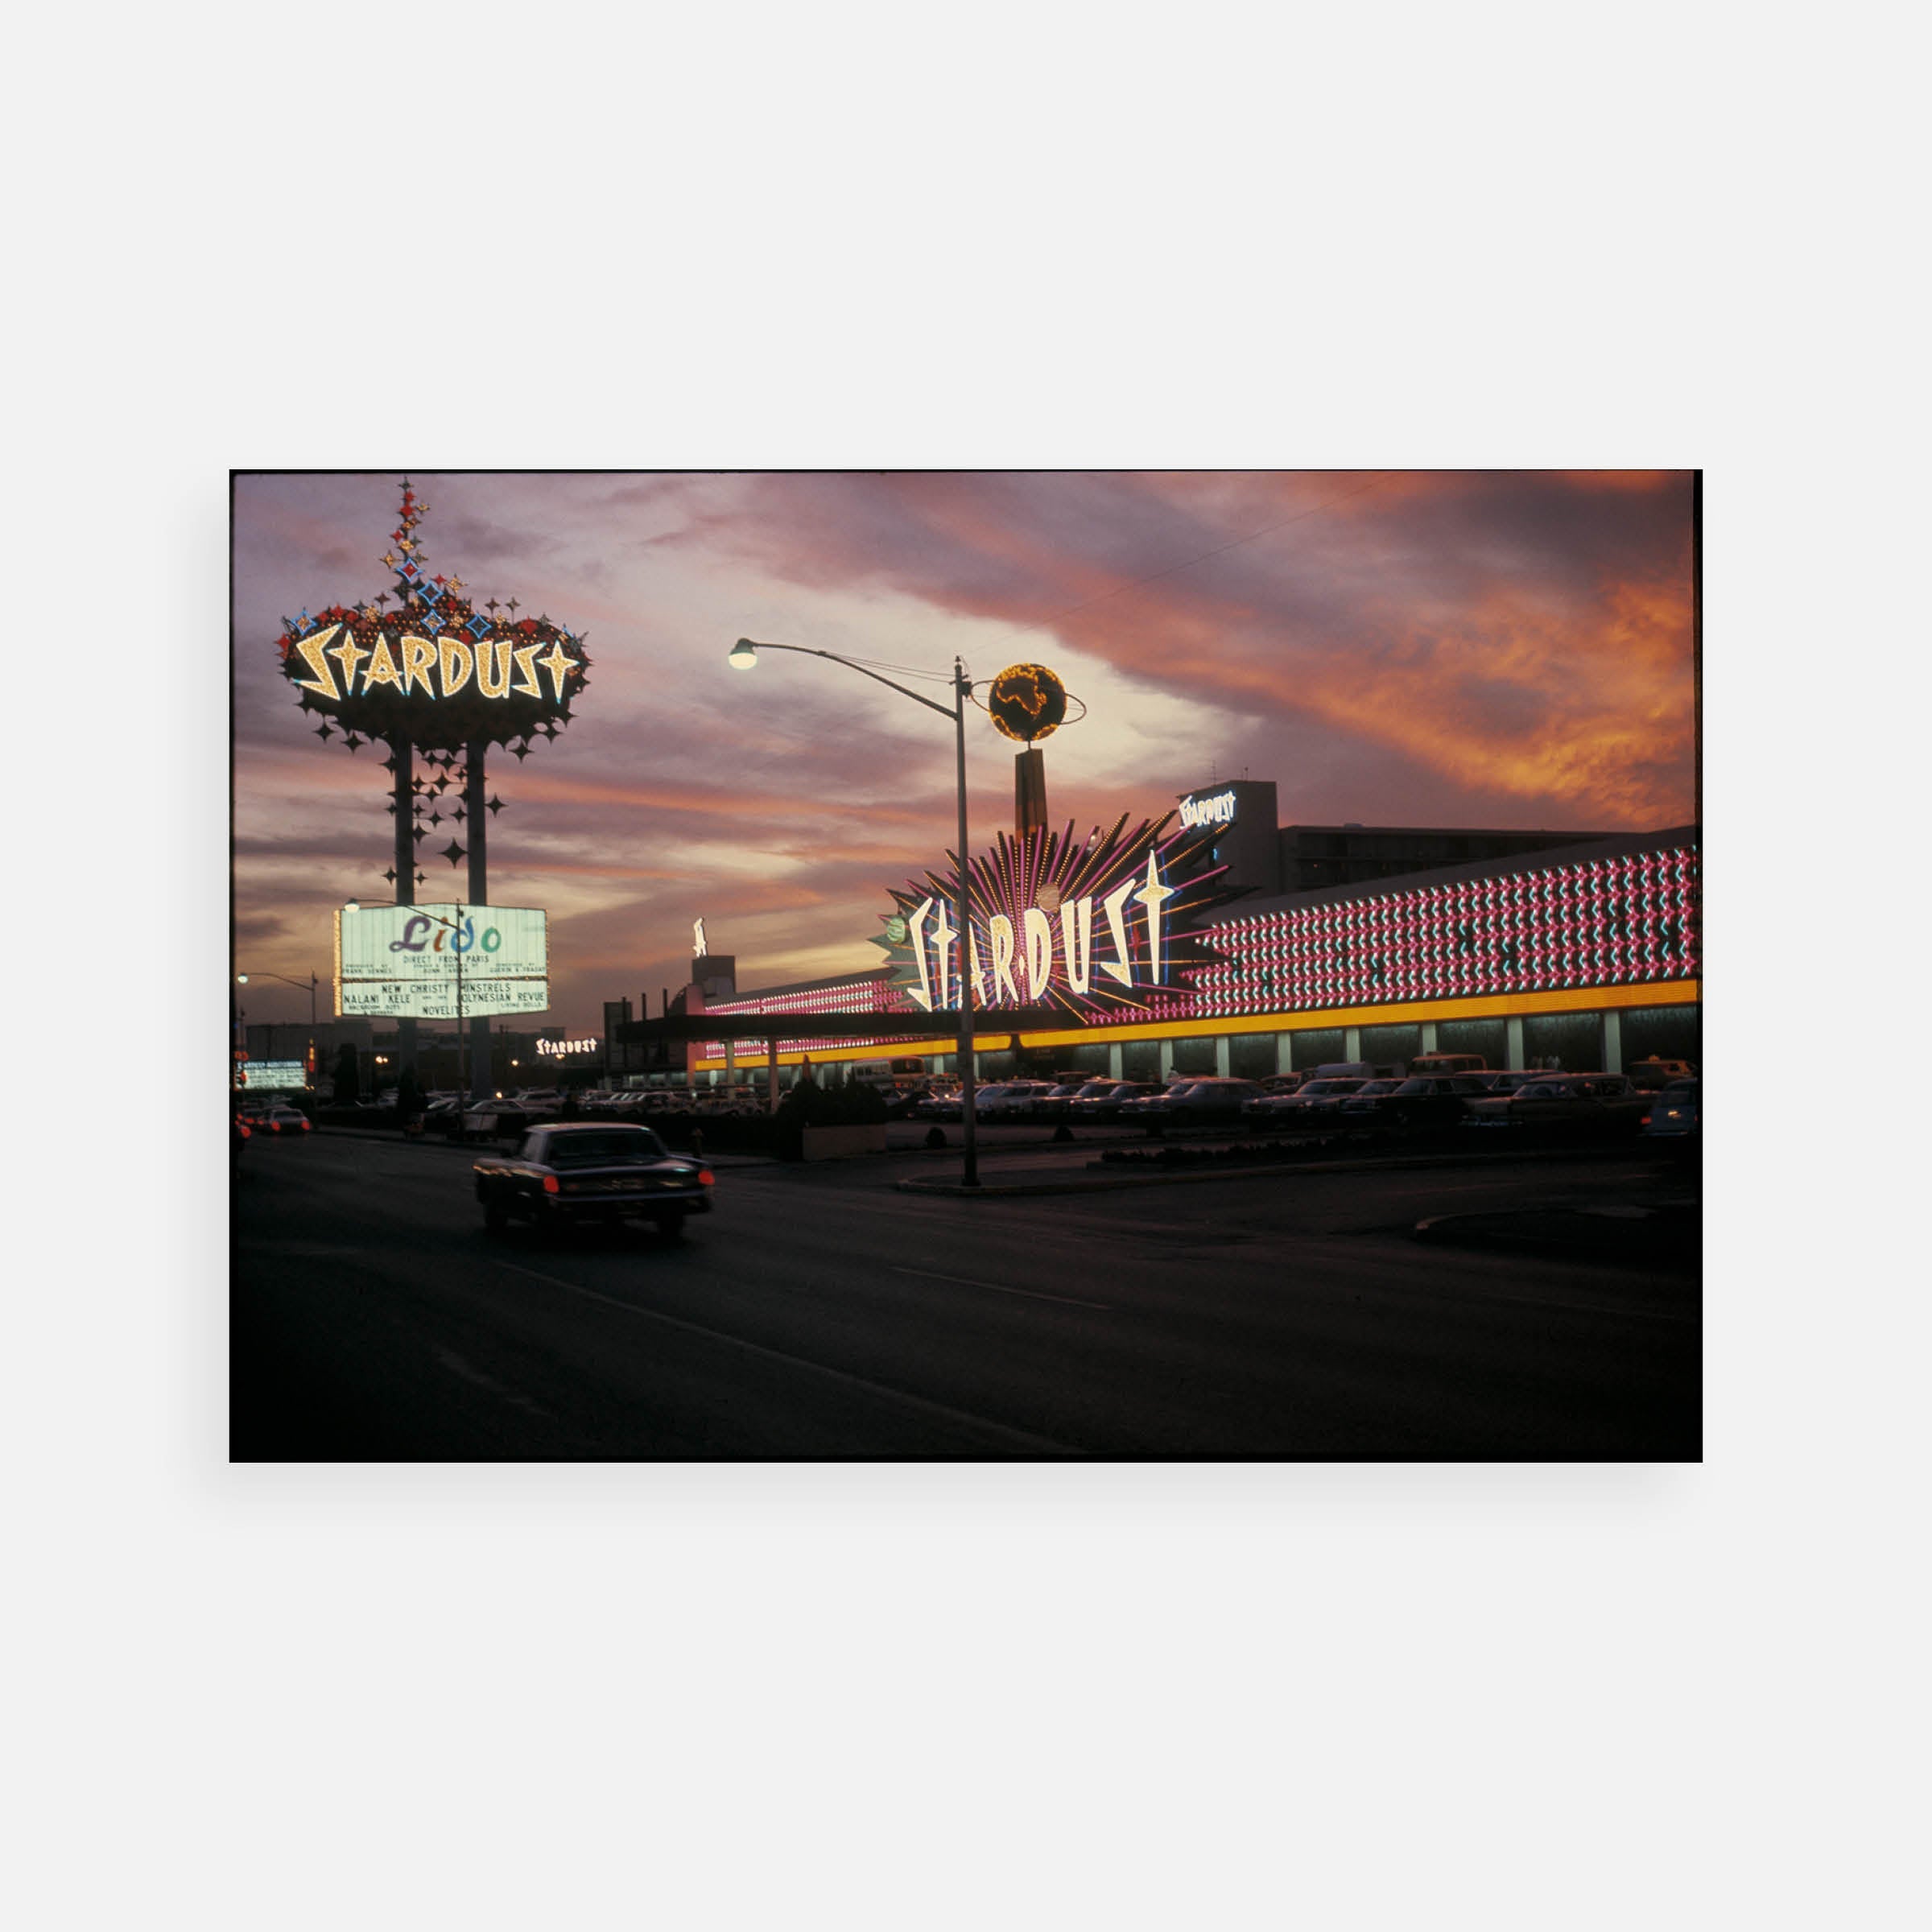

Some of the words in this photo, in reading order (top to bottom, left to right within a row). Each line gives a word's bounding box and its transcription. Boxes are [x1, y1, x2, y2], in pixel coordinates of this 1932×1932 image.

[293, 622, 580, 704] STARDUST
[1179, 790, 1236, 829] STARDUST
[389, 915, 502, 953] Lido
[906, 849, 1175, 1013] STARDUST
[403, 956, 432, 964] DIRECT
[466, 955, 489, 963] PARIS
[382, 984, 402, 994] NEW
[410, 984, 449, 993] CHRISTY
[458, 993, 511, 1003] OLYNESIAN
[518, 991, 545, 1001] REVUE
[343, 994, 380, 1005] NALANI
[388, 994, 411, 1004] KELE
[535, 1038, 598, 1055] STARDUST
